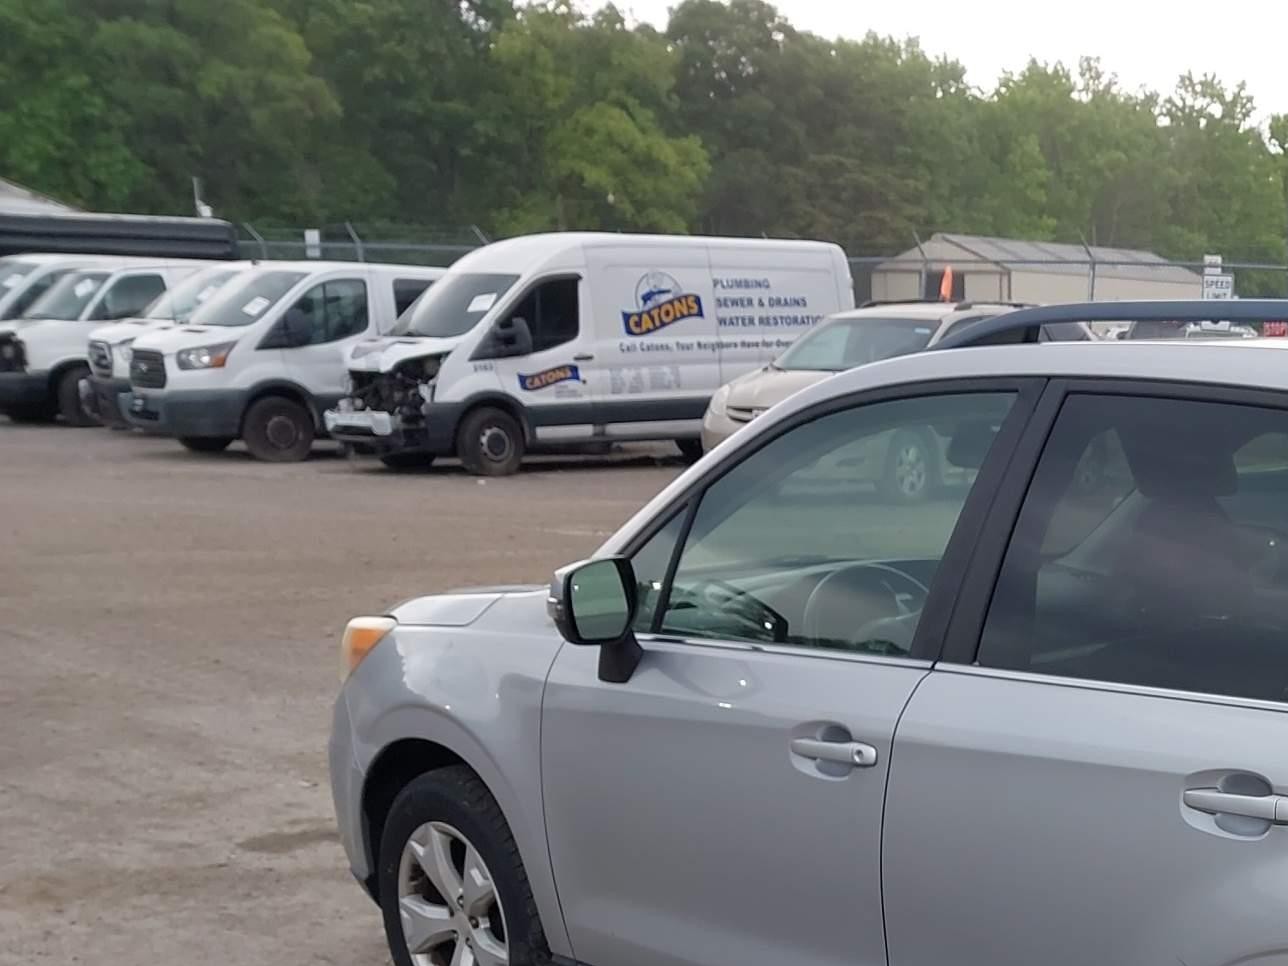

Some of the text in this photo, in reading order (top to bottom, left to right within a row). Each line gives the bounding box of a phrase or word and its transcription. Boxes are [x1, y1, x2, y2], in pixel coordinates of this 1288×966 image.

[712, 278, 770, 289] PLUMBING
[716, 297, 807, 308] SEWER & DRAINS
[629, 295, 699, 334] CATONS
[718, 315, 825, 327] WATER RESTORATI
[620, 342, 637, 352] Call
[526, 367, 571, 389] CATONS
